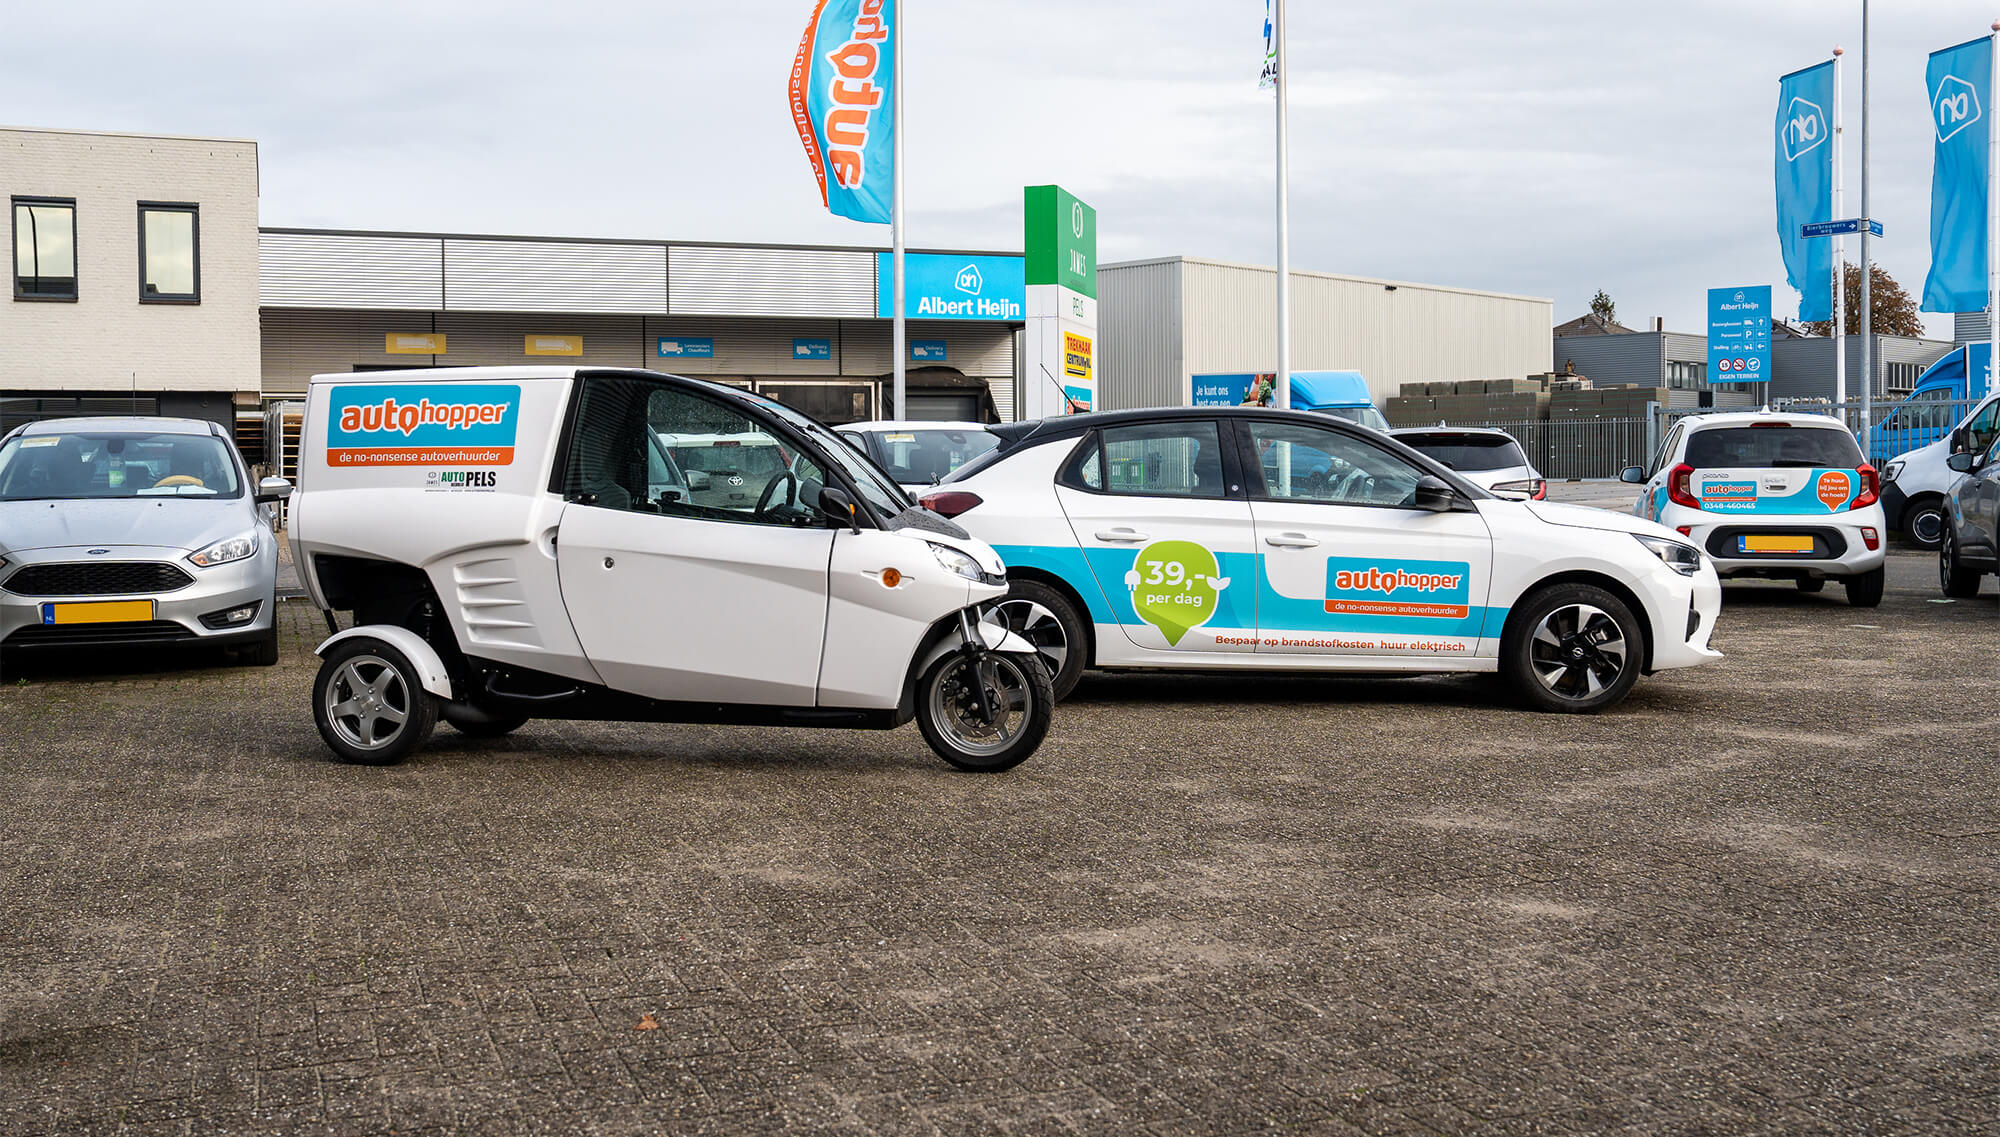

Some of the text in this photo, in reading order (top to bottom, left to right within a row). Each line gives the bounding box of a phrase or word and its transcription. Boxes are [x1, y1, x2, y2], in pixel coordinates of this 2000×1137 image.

[1070, 248, 1086, 278] JAMES
[917, 296, 1020, 320] Albert Heijn
[1742, 302, 1759, 310] Heijn
[1196, 384, 1229, 396] Je kunt ons
[340, 398, 507, 436] autohopper
[339, 450, 500, 462] de no-nonsense autoverhuurder
[441, 471, 496, 487] AUTO PELS
[1705, 484, 1754, 494] autohopper
[1144, 560, 1206, 591] 39,-
[1336, 568, 1460, 594] autohopper
[1146, 593, 1203, 607] per dag
[1335, 602, 1458, 615] de no-nonsense autoverhuurder
[1215, 635, 1466, 652] Bespaar op brandstofkosten huur elektrisch
